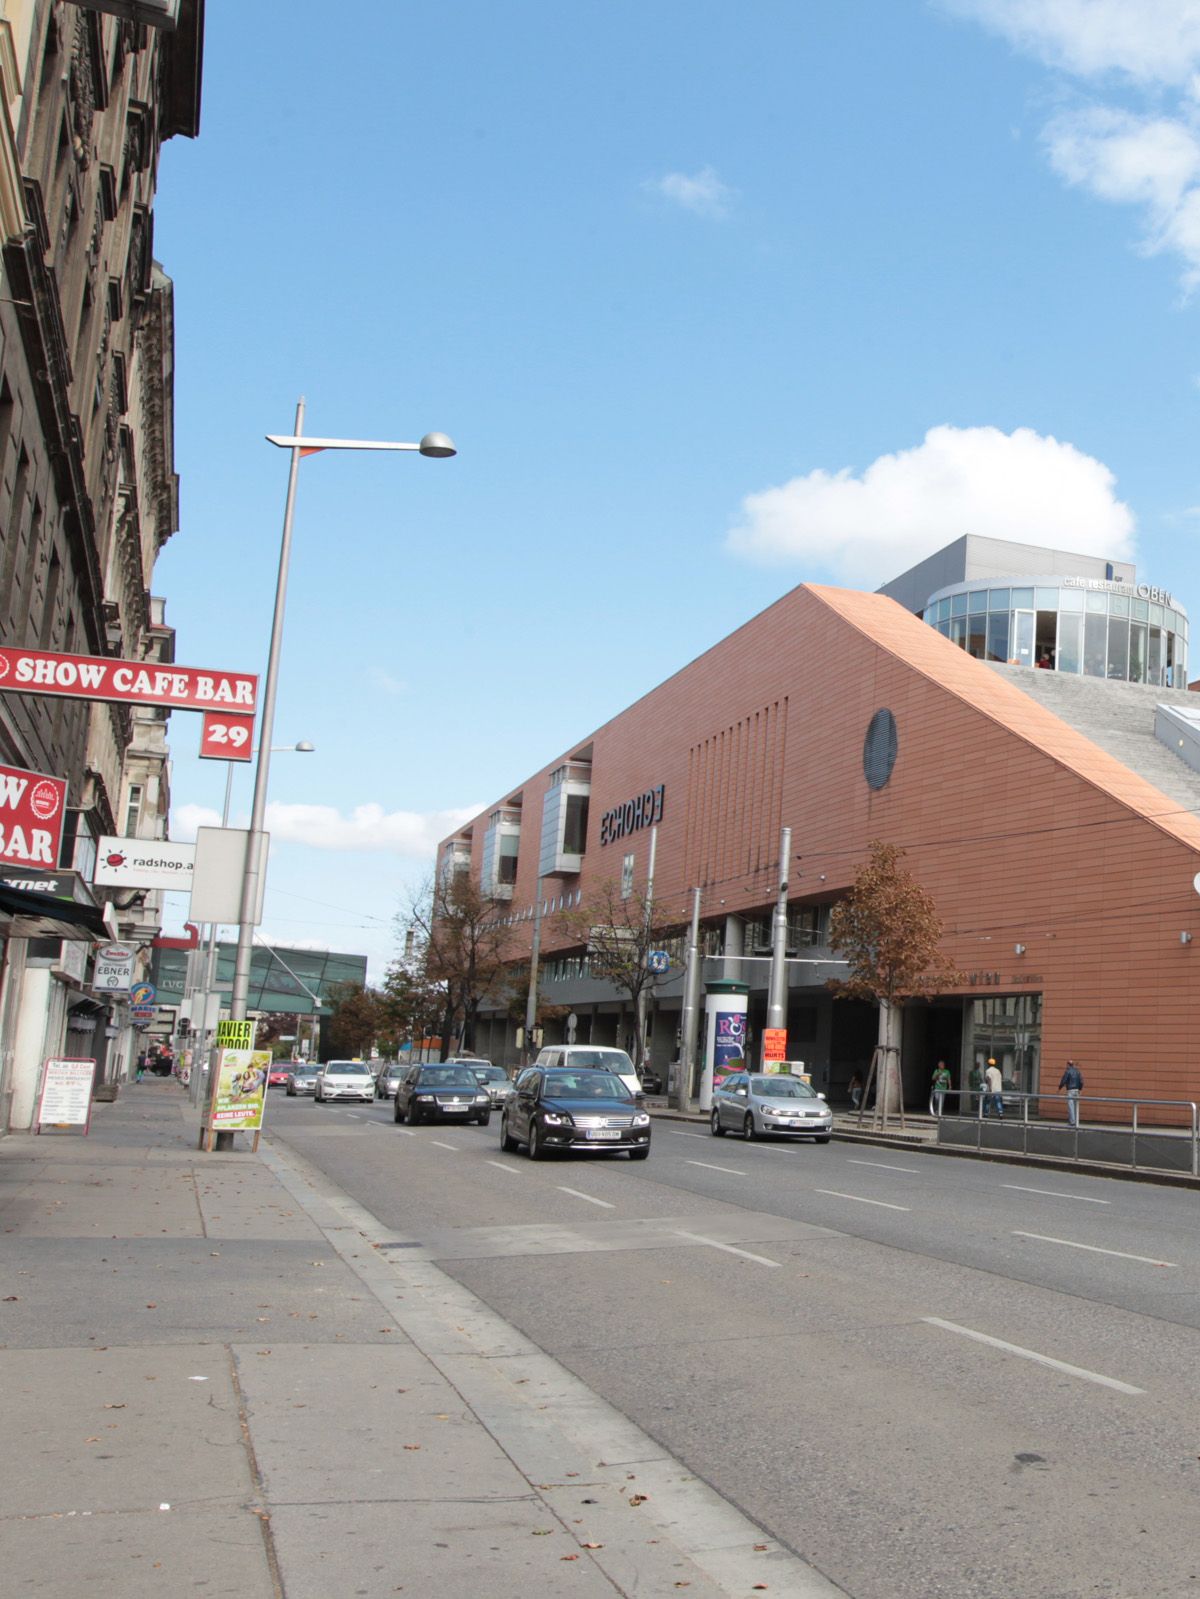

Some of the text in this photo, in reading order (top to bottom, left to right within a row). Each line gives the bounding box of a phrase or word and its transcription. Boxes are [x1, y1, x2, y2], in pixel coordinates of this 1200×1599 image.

[1088, 580, 1134, 593] restaurant
[1137, 582, 1174, 607] OBEN
[15, 657, 254, 705] SHOW CAFE BAR
[207, 724, 249, 748] 29
[0, 822, 54, 864] AR
[97, 966, 130, 976] EBNER
